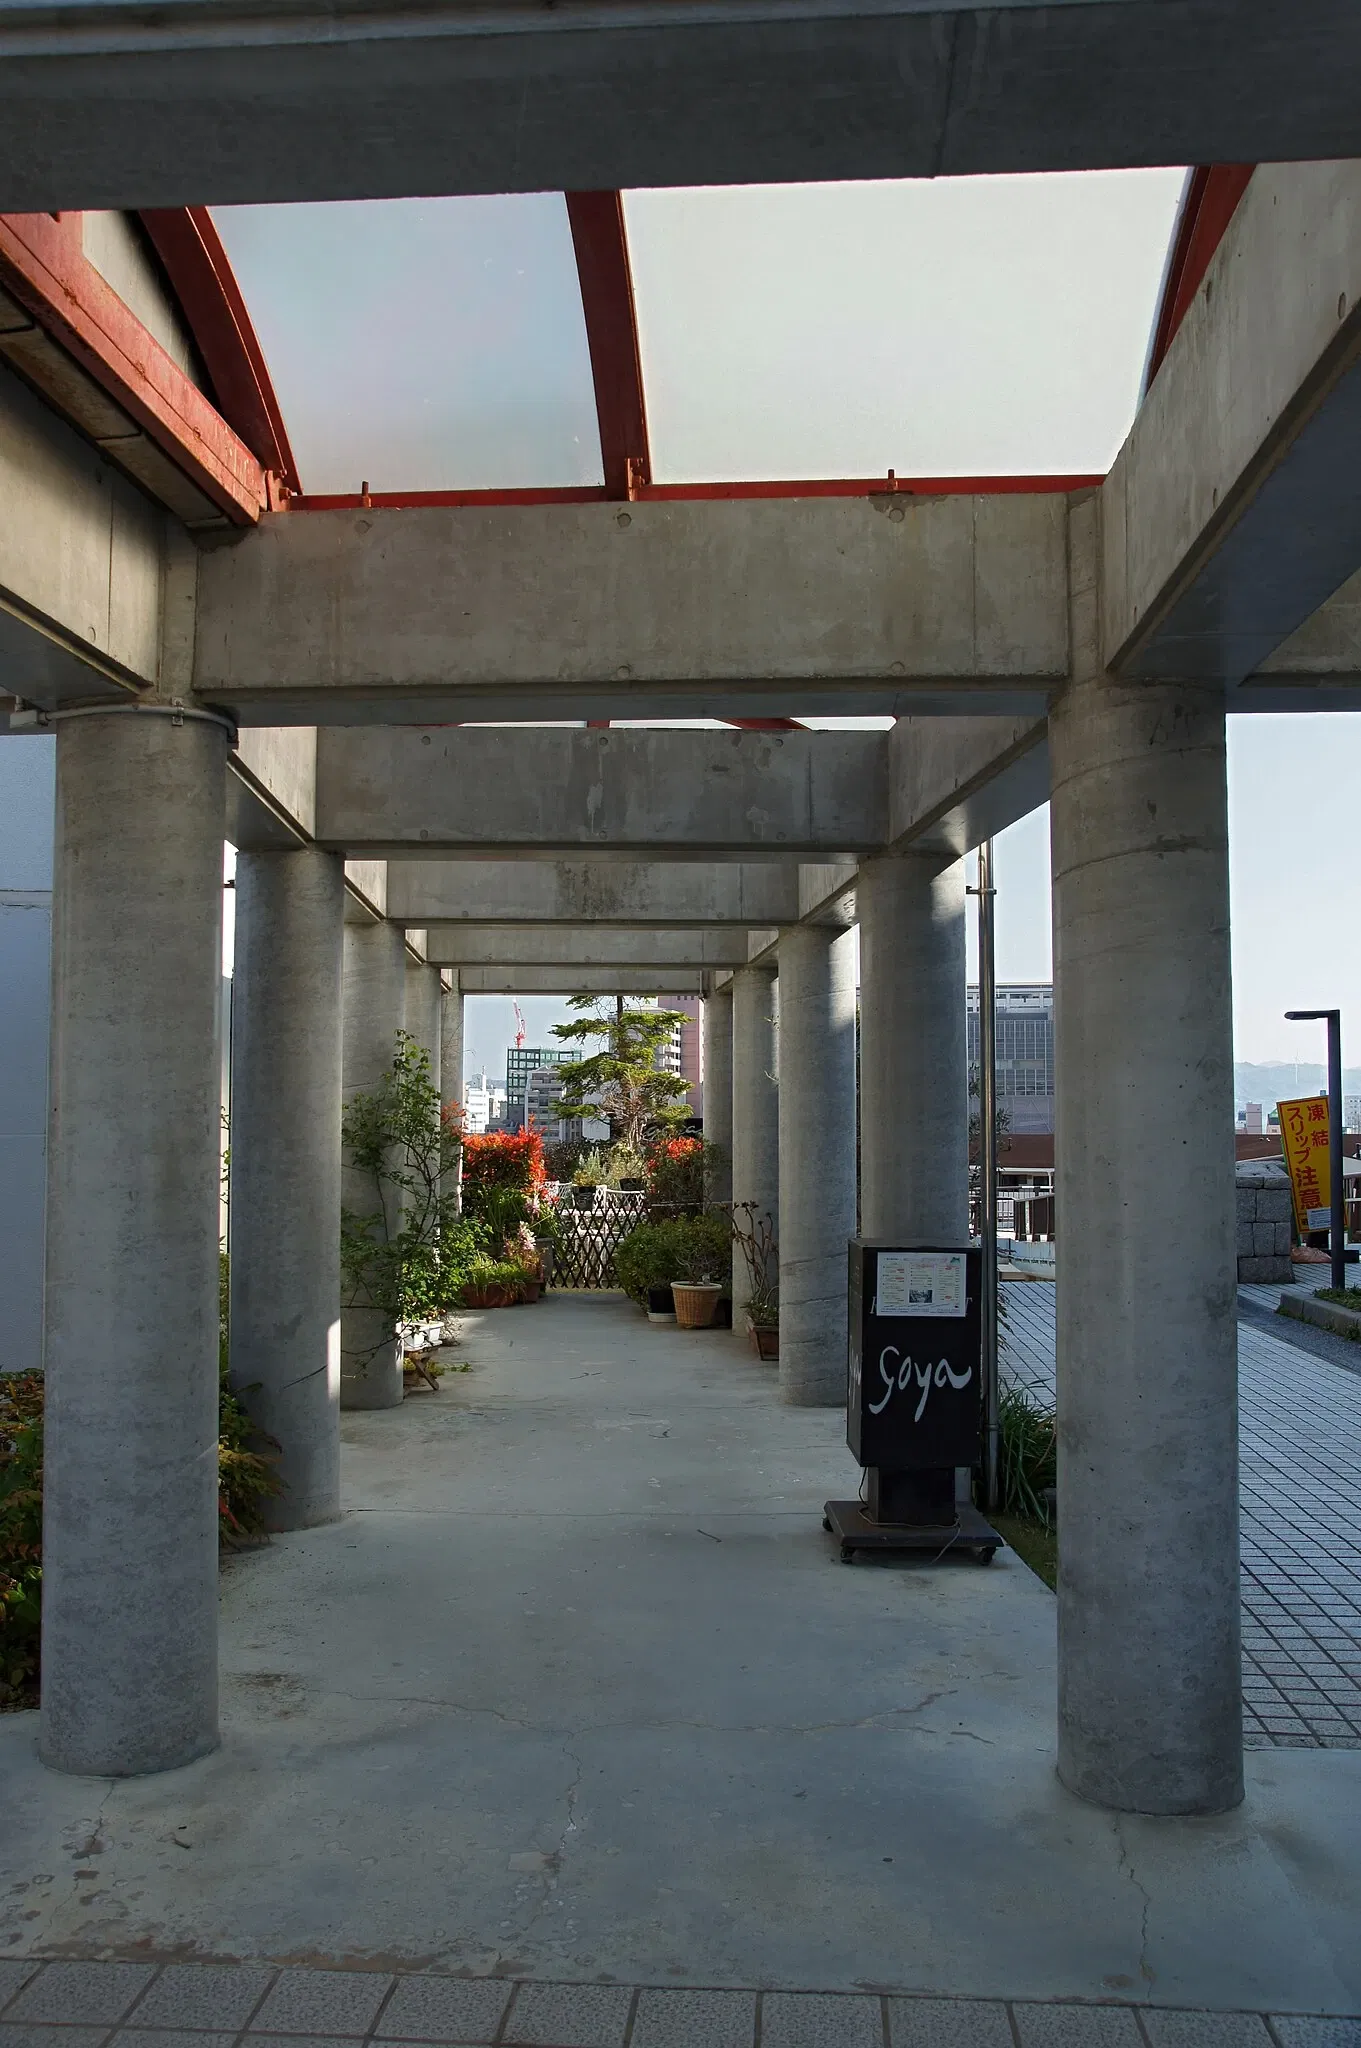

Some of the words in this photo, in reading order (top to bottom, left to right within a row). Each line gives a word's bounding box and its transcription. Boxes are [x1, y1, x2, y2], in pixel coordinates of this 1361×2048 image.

[1287, 1107, 1323, 1211] スリップ注意
[1307, 1104, 1329, 1147] 凍結
